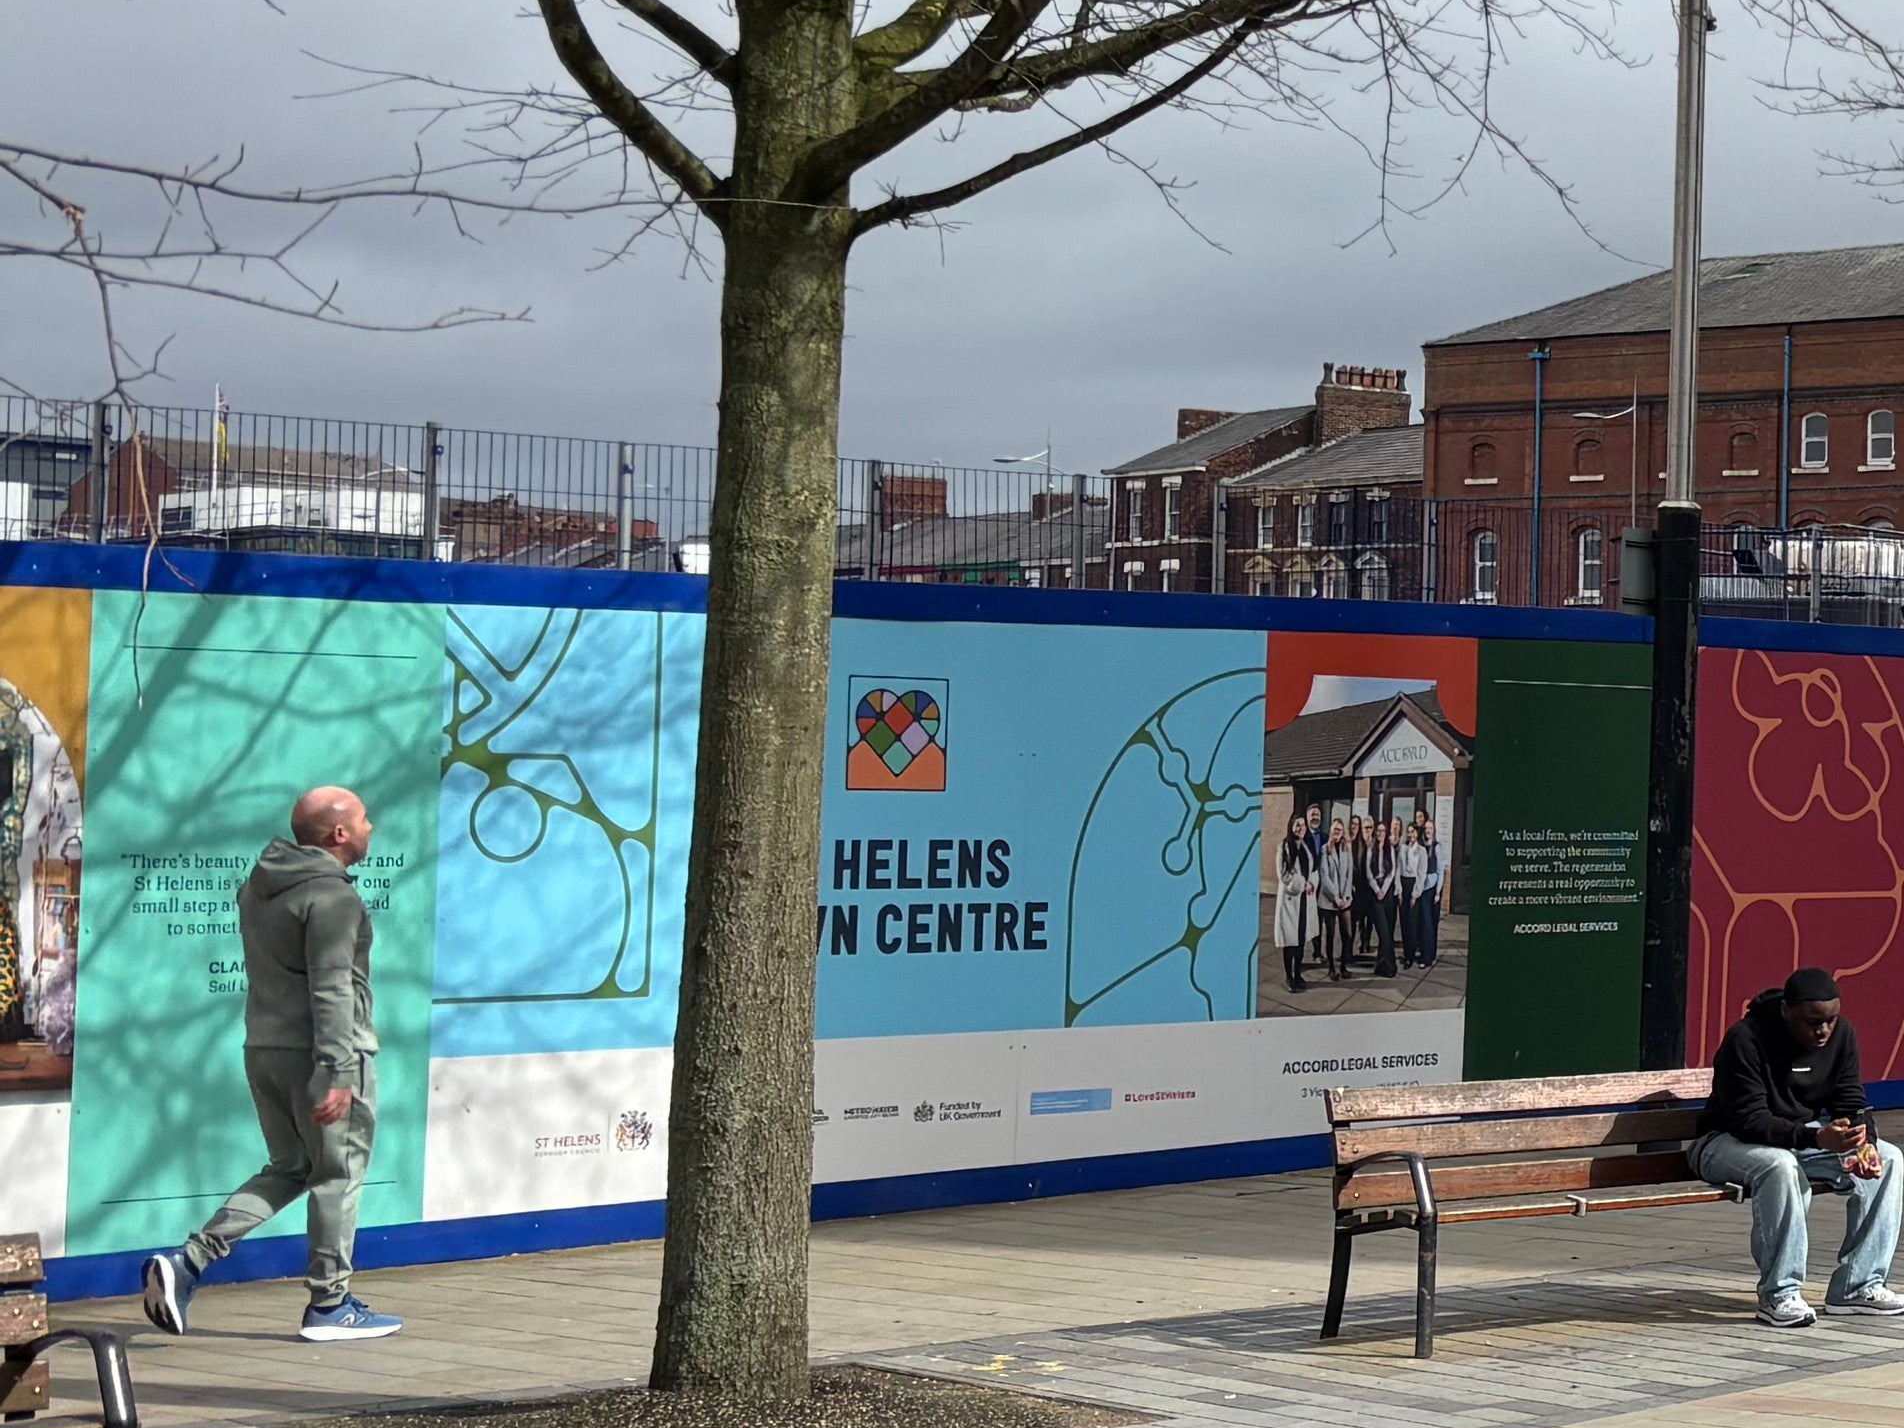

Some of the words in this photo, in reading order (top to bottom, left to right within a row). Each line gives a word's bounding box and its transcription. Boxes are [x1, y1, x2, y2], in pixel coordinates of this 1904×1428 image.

[1523, 829, 1545, 841] local
[1505, 847, 1516, 857] to
[1517, 846, 1566, 860] supporting
[1567, 845, 1582, 857] the
[194, 852, 250, 875] beauty
[376, 853, 404, 868] and
[833, 839, 1011, 890] HELENS
[1510, 863, 1523, 873] we
[1552, 861, 1570, 873] The
[134, 875, 151, 891] St
[157, 874, 214, 891] Helens
[217, 875, 232, 890] is
[363, 877, 391, 889] one
[1499, 878, 1547, 892] represents
[1555, 877, 1573, 889] real
[131, 896, 180, 914] small
[183, 898, 218, 917] step
[1488, 895, 1517, 906] create
[1525, 896, 1549, 905] more
[1550, 893, 1582, 905] vibrant
[167, 922, 184, 936] to
[187, 921, 241, 936] somet
[876, 901, 1049, 955] CENTRE
[1513, 922, 1551, 934] ACCORD
[1552, 922, 1579, 933] LEGAL
[1579, 921, 1619, 932] SERVICES
[1282, 1058, 1339, 1075] ACCORD
[1340, 1056, 1379, 1072] LEGAL
[1381, 1052, 1439, 1069] SERVICES
[1301, 1087, 1308, 1098] 3
[939, 1101, 970, 1112] Funded
[970, 1101, 982, 1112] by
[939, 1112, 953, 1122] UK
[953, 1109, 1002, 1121] Government
[535, 1137, 551, 1149] ST
[554, 1134, 601, 1148] HELENS
